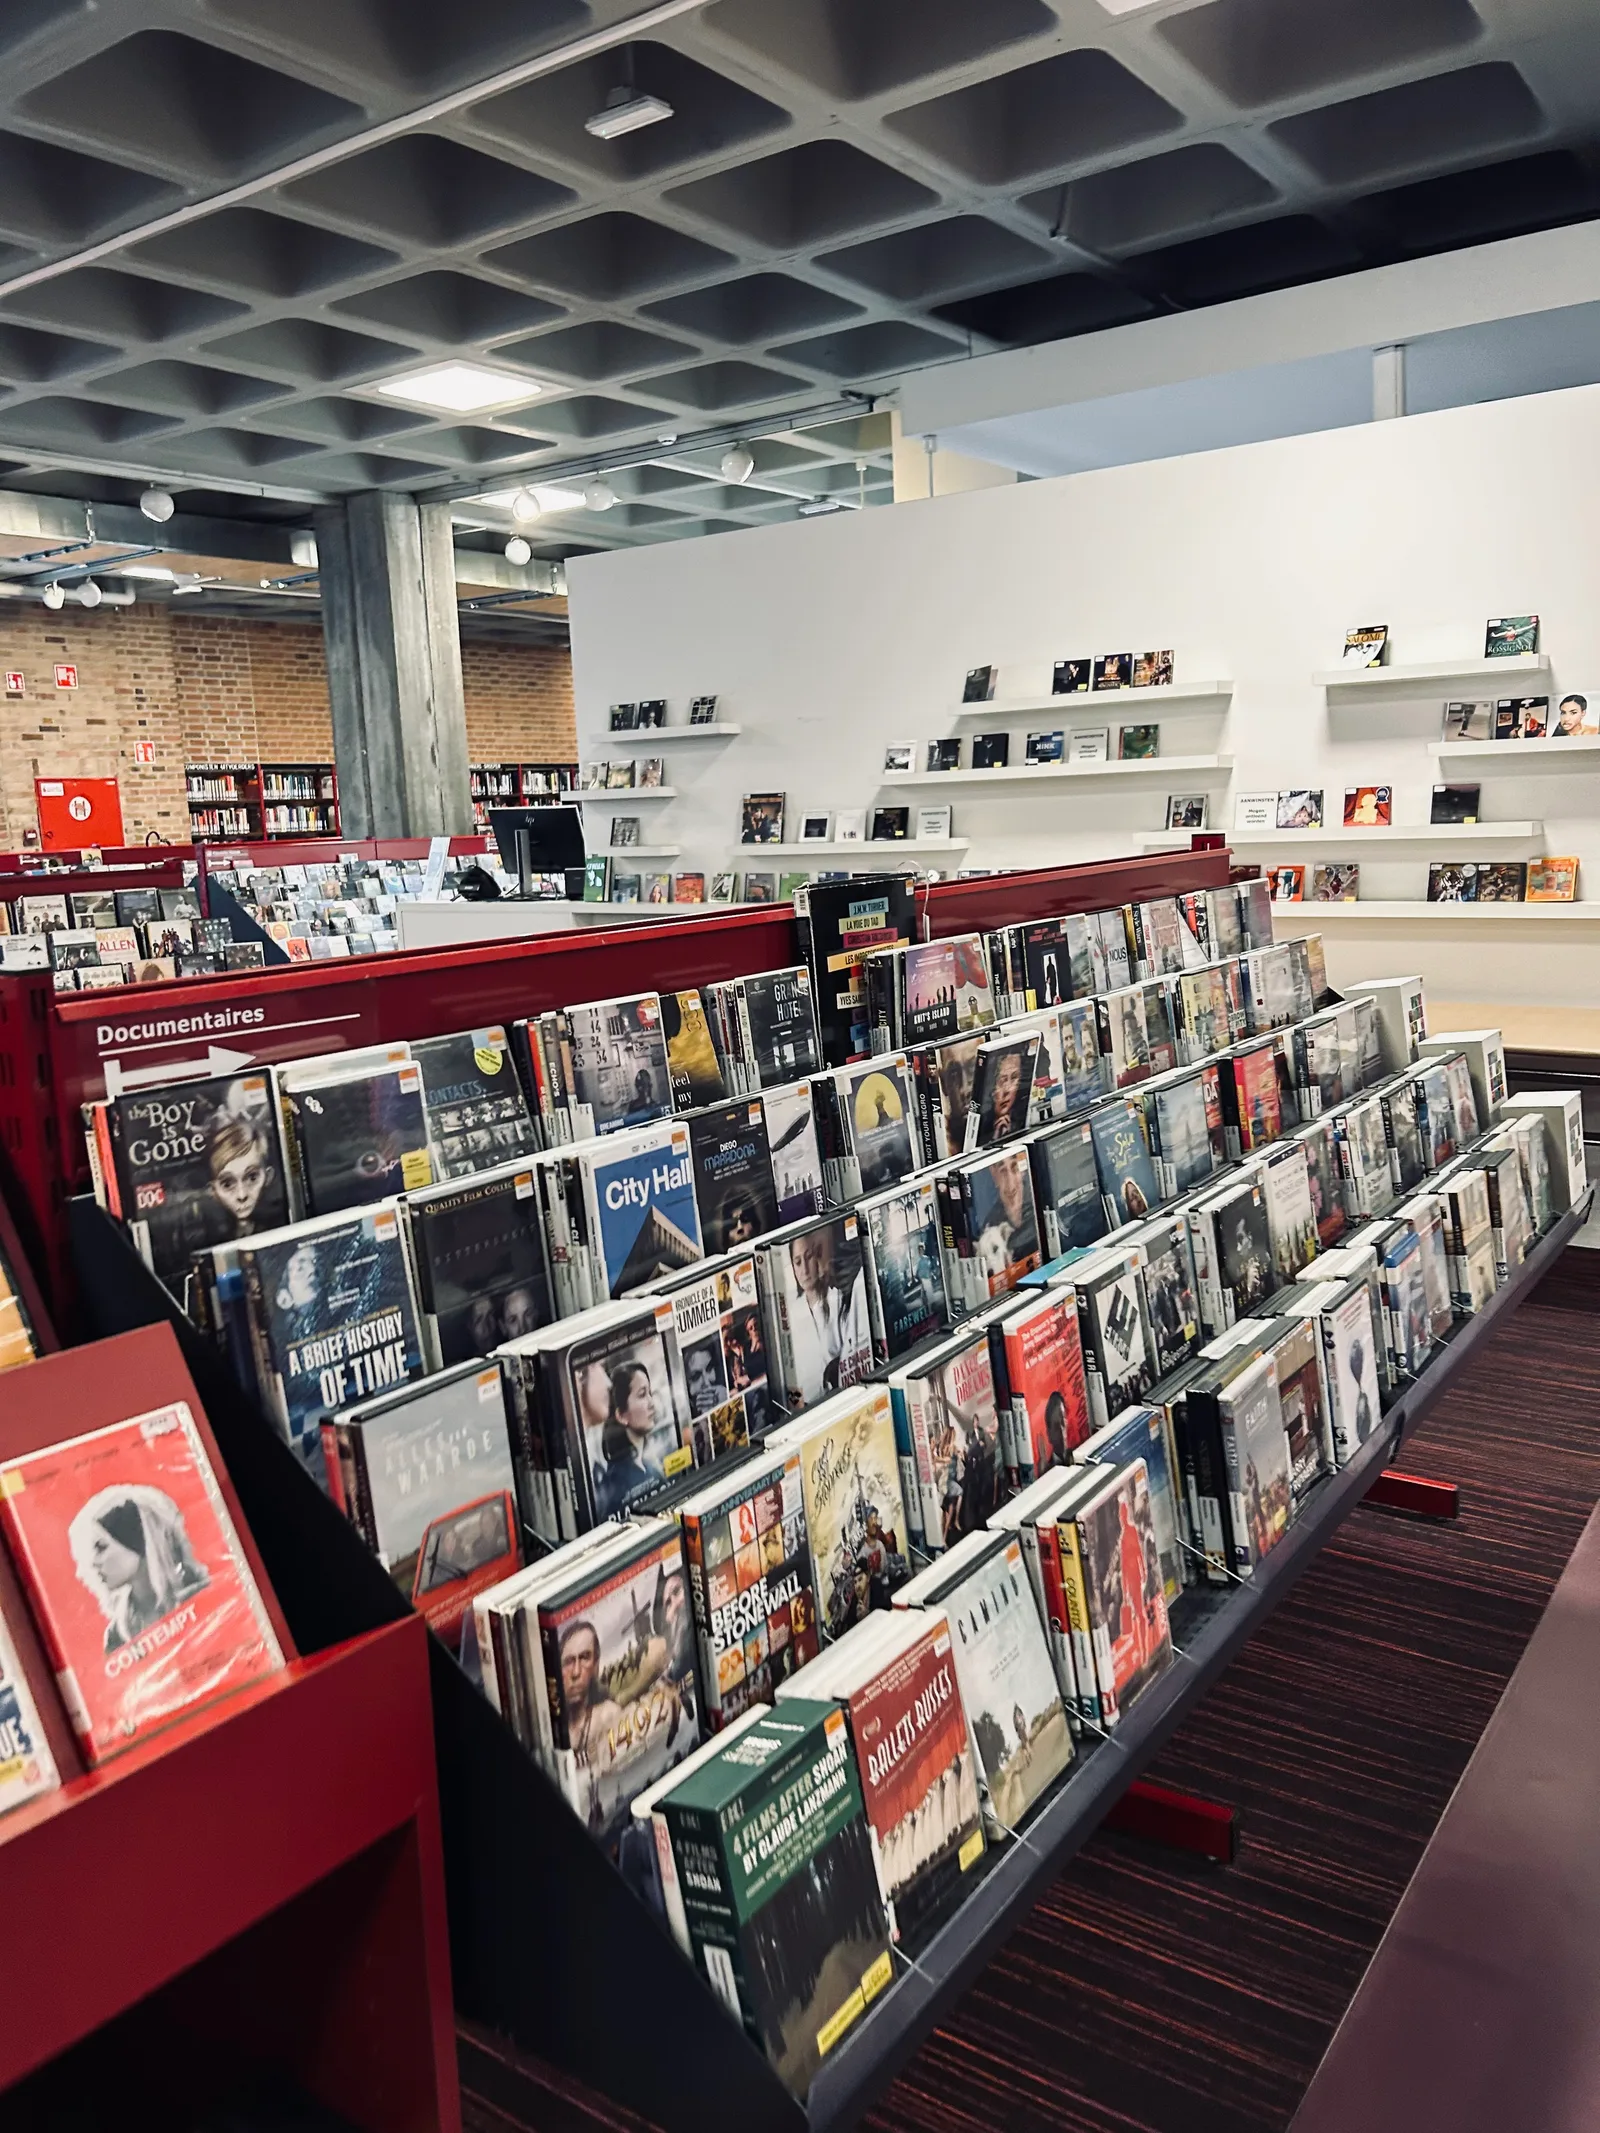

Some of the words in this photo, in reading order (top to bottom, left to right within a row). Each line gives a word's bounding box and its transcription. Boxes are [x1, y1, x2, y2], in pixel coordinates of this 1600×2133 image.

[1487, 638, 1533, 653] ROSSIGNOL
[868, 901, 886, 913] TURNER
[99, 940, 136, 952] ALLEN
[1109, 947, 1126, 961] NOUS
[845, 955, 854, 965] LES
[774, 981, 803, 1002] GRAN
[840, 995, 851, 1005] YVES
[777, 1001, 804, 1021] HOTEL
[878, 1009, 887, 1026] CITY
[932, 1006, 950, 1020] ISLAND
[97, 1007, 265, 1046] Documentaires
[591, 1021, 601, 1034] 14
[591, 1036, 601, 1048] 24
[548, 1061, 561, 1098] ECHO'S
[671, 1071, 691, 1088] feel
[427, 1080, 487, 1106] ONTACTS.
[678, 1091, 692, 1104] my
[128, 1104, 151, 1120] the
[147, 1100, 197, 1131] Boy
[161, 1124, 177, 1140] is
[129, 1131, 207, 1166] Gone
[704, 1143, 756, 1171] MARADONA
[720, 1139, 737, 1152] DIEGO
[605, 1175, 650, 1211] City
[652, 1157, 692, 1196] Hall
[136, 1189, 164, 1208] DOC
[424, 1198, 461, 1215] QUALITY
[463, 1191, 483, 1207] FILM
[484, 1181, 514, 1199] COLLEC
[675, 1292, 701, 1312] HRONICLE
[289, 1350, 301, 1377] A
[303, 1336, 345, 1371] BRIEF
[347, 1311, 404, 1356] HISTORY
[320, 1367, 348, 1408] OF
[350, 1341, 410, 1396] TIME
[956, 1369, 991, 1406] DREAMS
[398, 1430, 493, 1494] WAARDE
[720, 1475, 771, 1516] ANNIVERSARY
[690, 1562, 706, 1624] BEFORE
[711, 1577, 768, 1634] BEFORE
[714, 1570, 803, 1652] STONEWALL
[104, 1603, 198, 1678] CONTEMPT
[867, 1709, 916, 1787] BALLETS
[914, 1663, 953, 1731] RUSSES
[742, 1802, 778, 1849] FILMS
[780, 1772, 813, 1816] AFTER
[812, 1744, 848, 1785] SHOAH
[743, 1846, 758, 1876] BY
[758, 1811, 798, 1860] CLAUDE
[797, 1767, 847, 1824] LANZMANN
[685, 1870, 722, 1893] SHOAH
